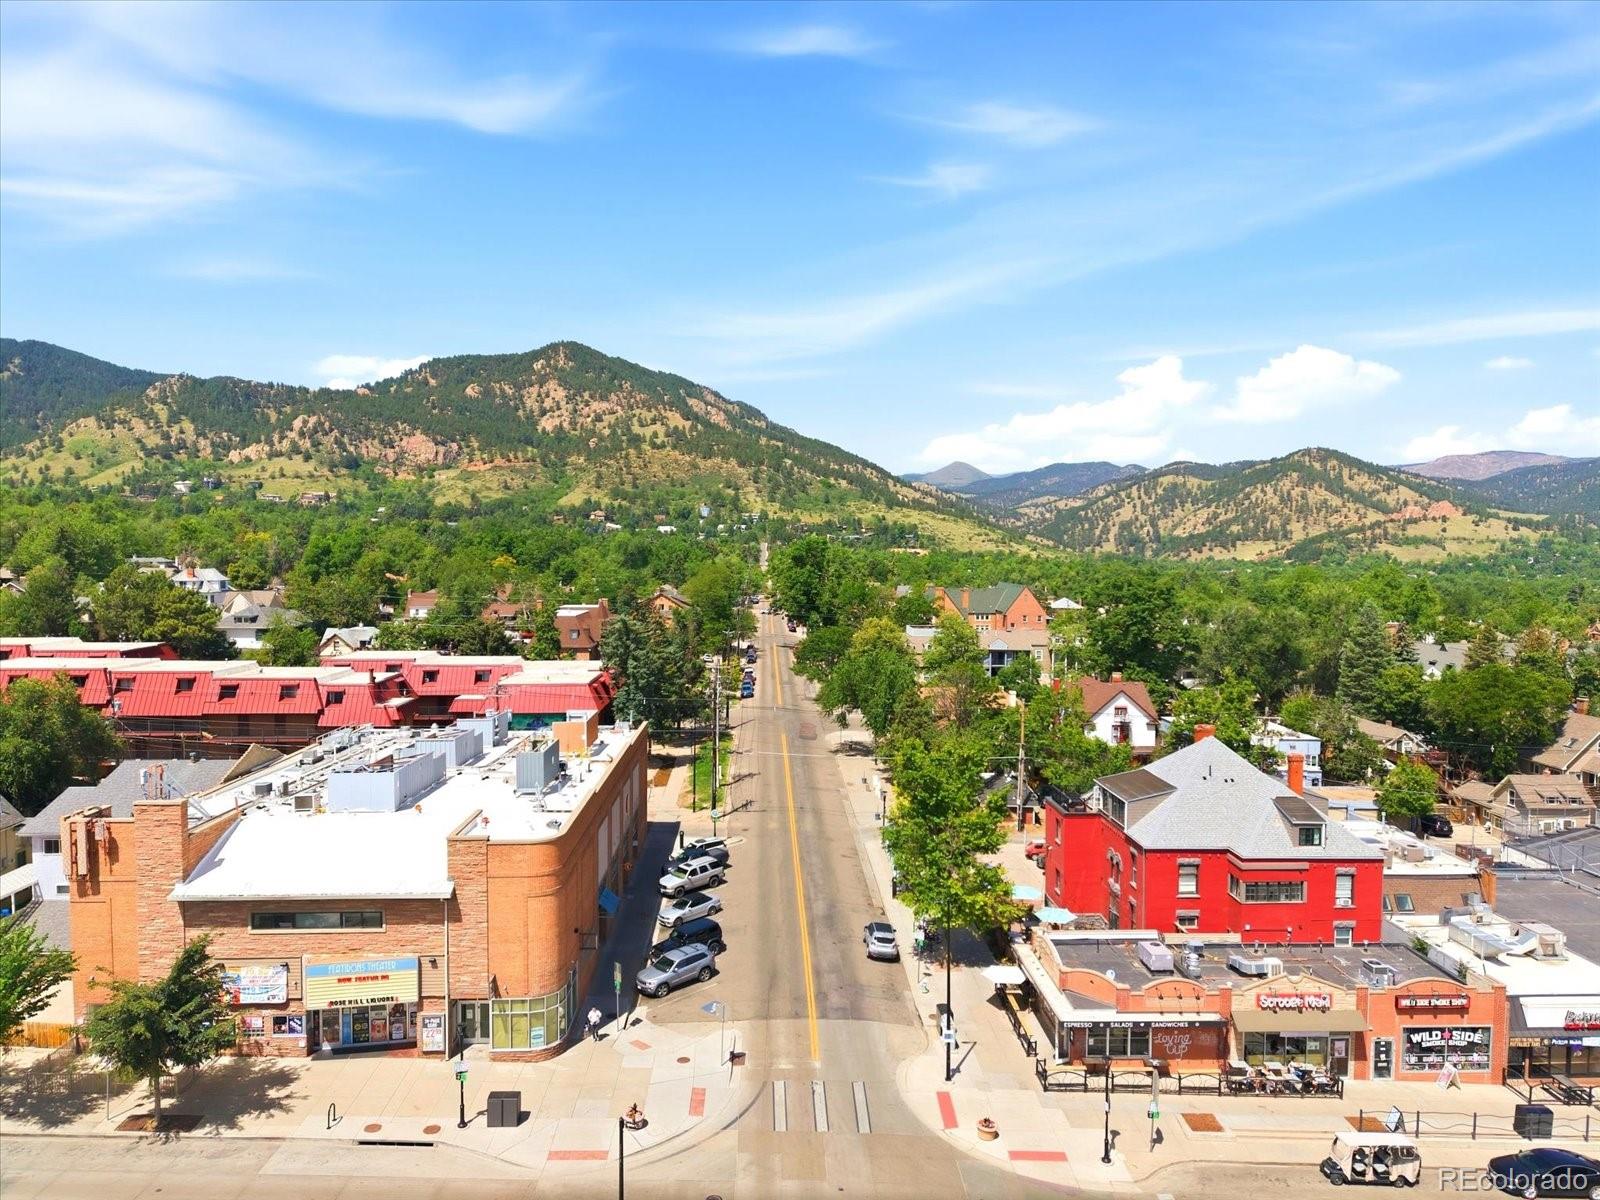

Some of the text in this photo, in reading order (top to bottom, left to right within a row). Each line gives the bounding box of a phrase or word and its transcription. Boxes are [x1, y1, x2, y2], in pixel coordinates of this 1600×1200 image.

[1410, 1030, 1484, 1044] WILD SIDE
[1421, 1039, 1468, 1048] SMOKE SHOP
